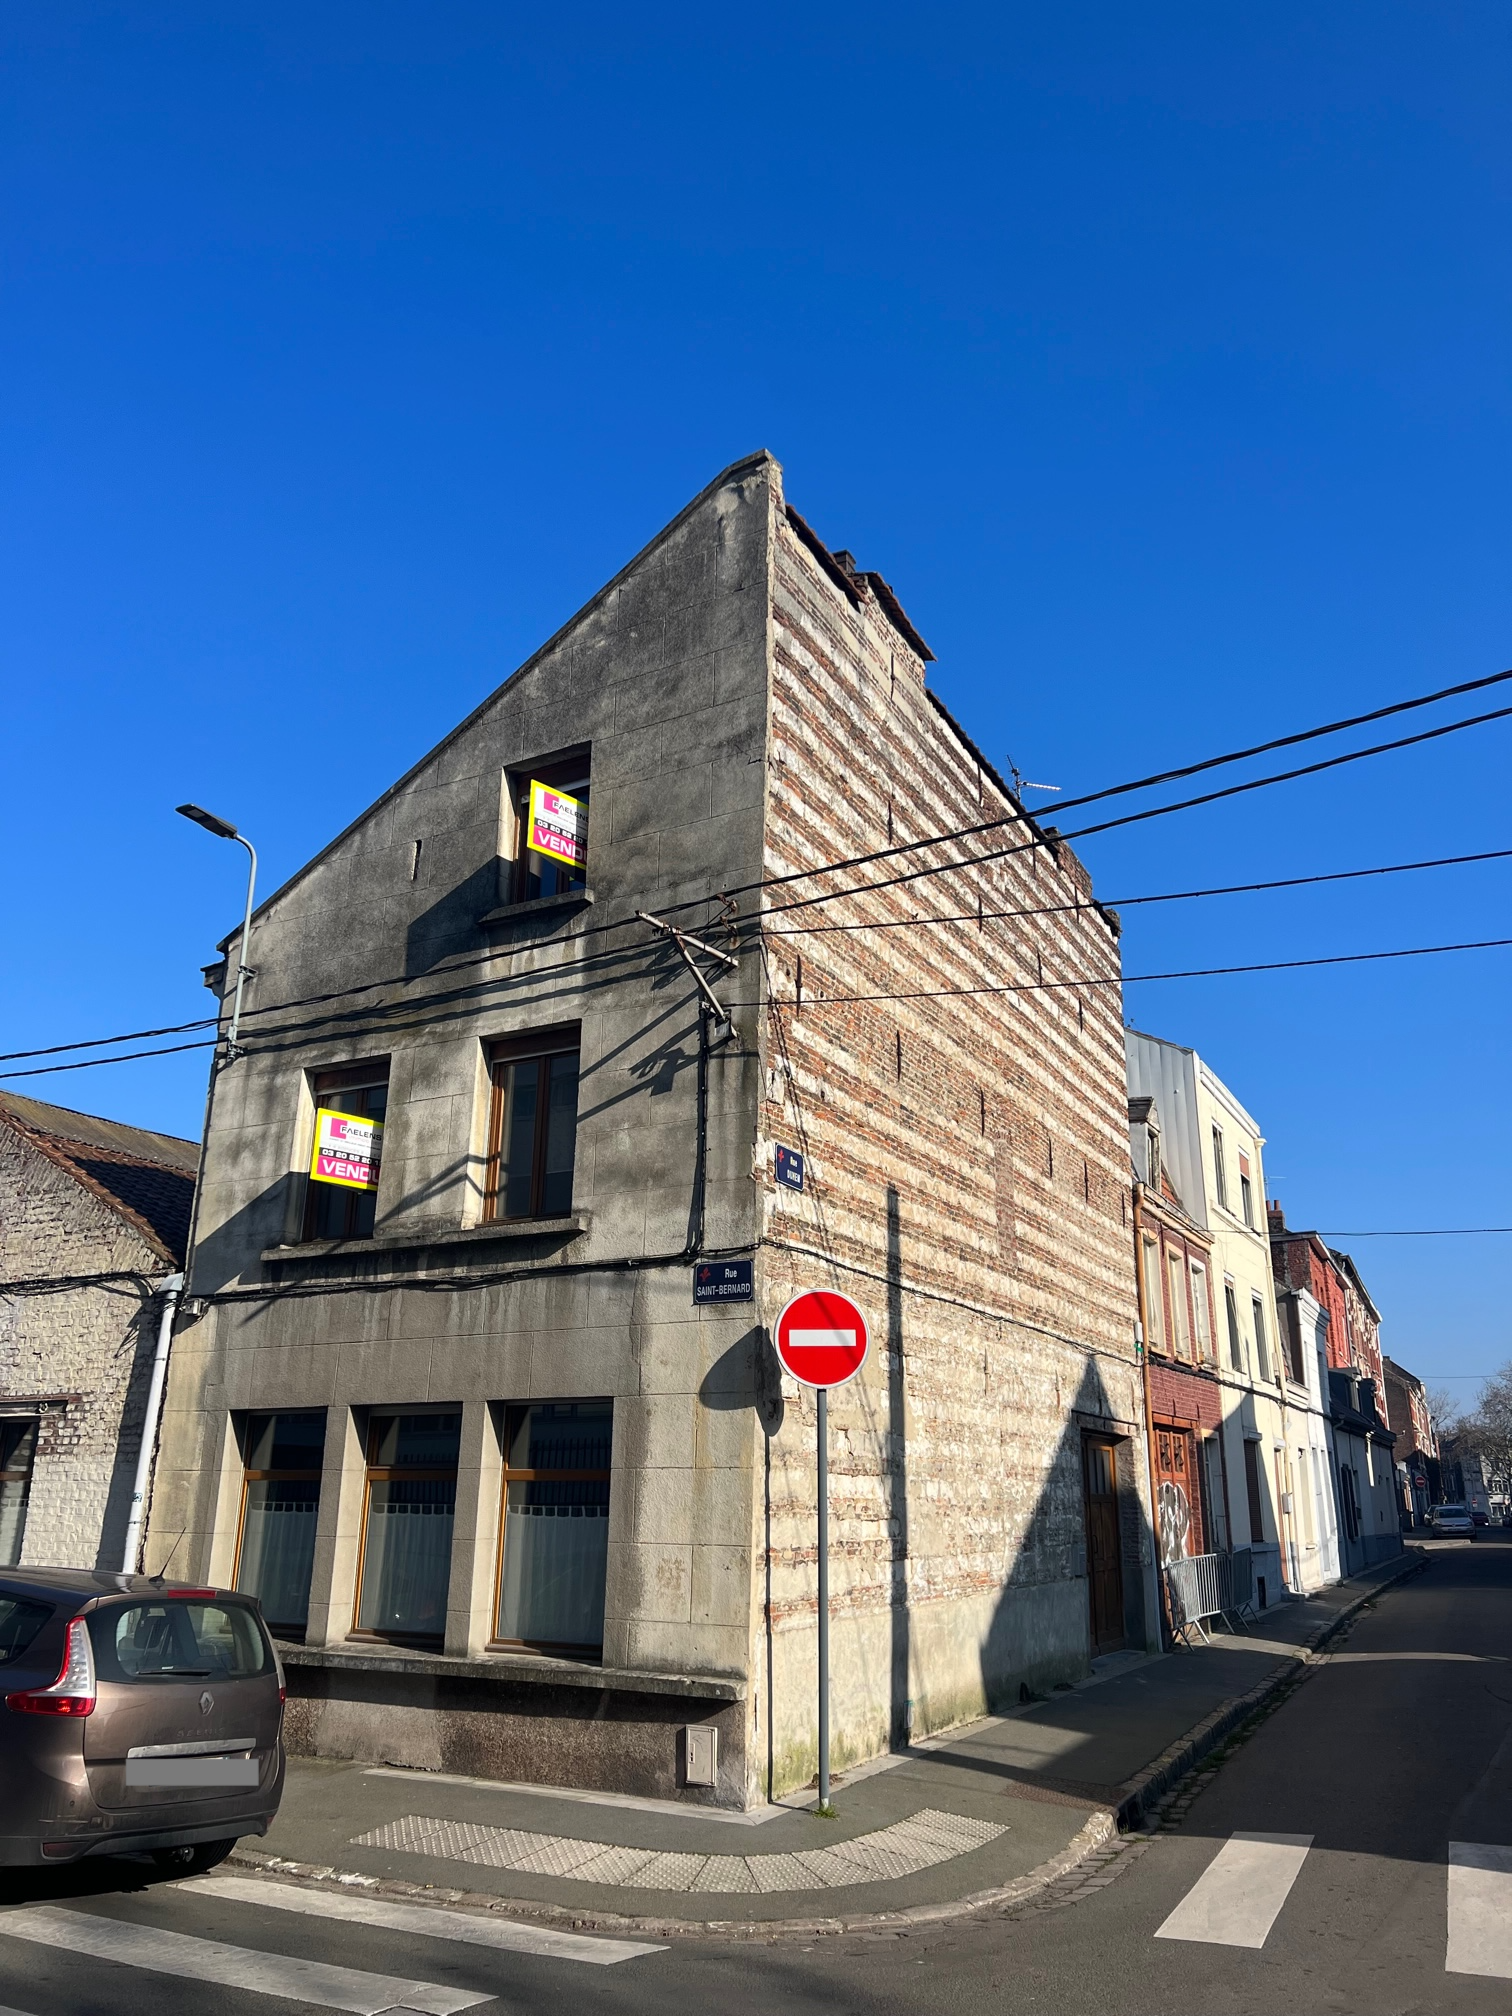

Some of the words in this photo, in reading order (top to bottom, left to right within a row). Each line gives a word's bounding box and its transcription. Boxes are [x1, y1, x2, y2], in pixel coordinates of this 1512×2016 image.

[341, 1126, 382, 1141] FAELENS
[322, 1148, 334, 1157] 03
[335, 1151, 348, 1159] 20
[349, 1153, 360, 1162] 52
[724, 1268, 738, 1279] Rue
[696, 1282, 751, 1297] SAINT-BERNARD
